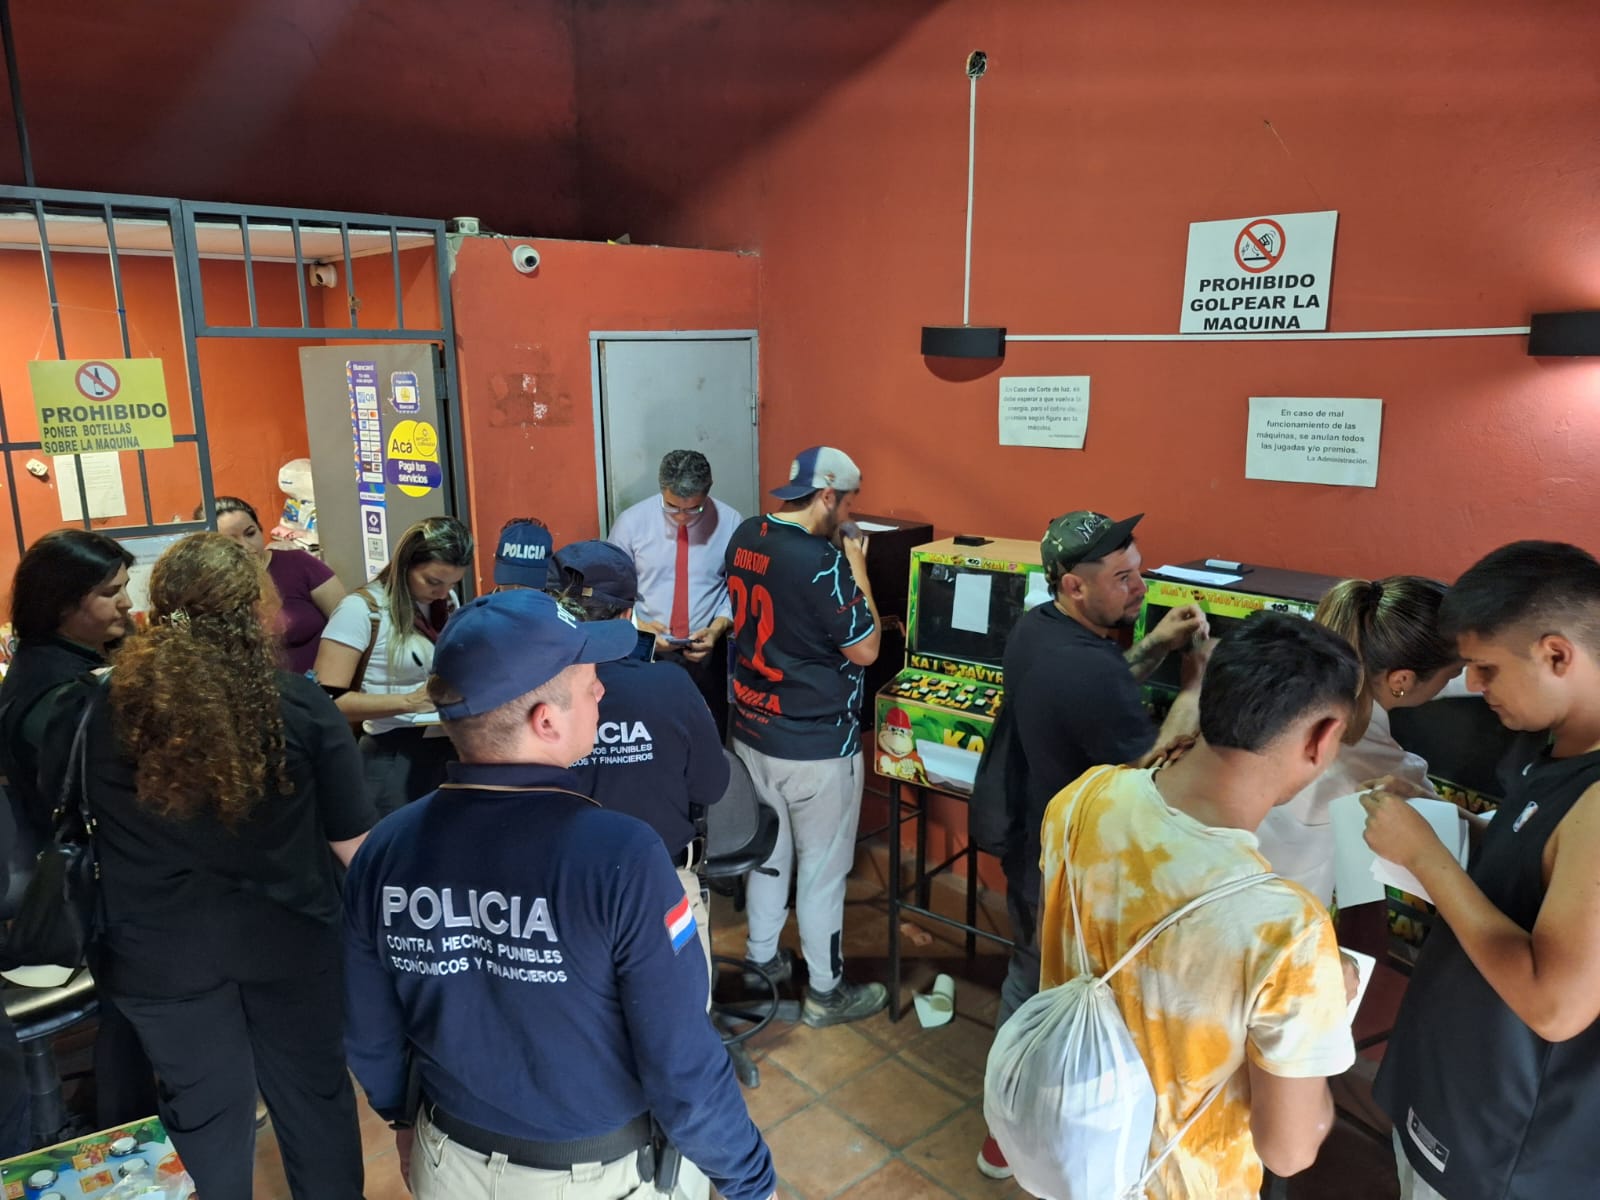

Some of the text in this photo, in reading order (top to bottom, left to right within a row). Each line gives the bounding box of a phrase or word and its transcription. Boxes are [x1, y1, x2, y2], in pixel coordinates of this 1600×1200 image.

[1199, 274, 1315, 292] PROHIBIDO
[1190, 294, 1320, 312] GOLPEAR LA
[1203, 316, 1301, 330] MAQUINA
[42, 403, 167, 424] PROHIBIDO
[1281, 409, 1291, 417] En
[43, 423, 132, 439] PONER BOTELLAS
[1266, 420, 1329, 429] funcionamiento
[1345, 422, 1356, 430] las
[1257, 432, 1297, 440] máquinas,
[44, 437, 139, 453] SOBRE LA MAQUINA
[392, 439, 413, 454] Acá
[1261, 442, 1272, 450] las
[1273, 443, 1306, 452] jugadas
[1308, 445, 1321, 453] y/o
[415, 461, 427, 472] tus
[399, 473, 428, 484] servicios
[502, 543, 546, 560] POLICIA
[610, 744, 653, 754] PUNIBLES
[591, 757, 598, 765] Y
[600, 753, 654, 764] FINANCIEROS
[383, 886, 558, 942] POLICIA
[386, 934, 563, 964] CONTRA HECHOS PUNIBLES
[391, 954, 567, 983] ECONÓMICOS Y FINANCIEROS
